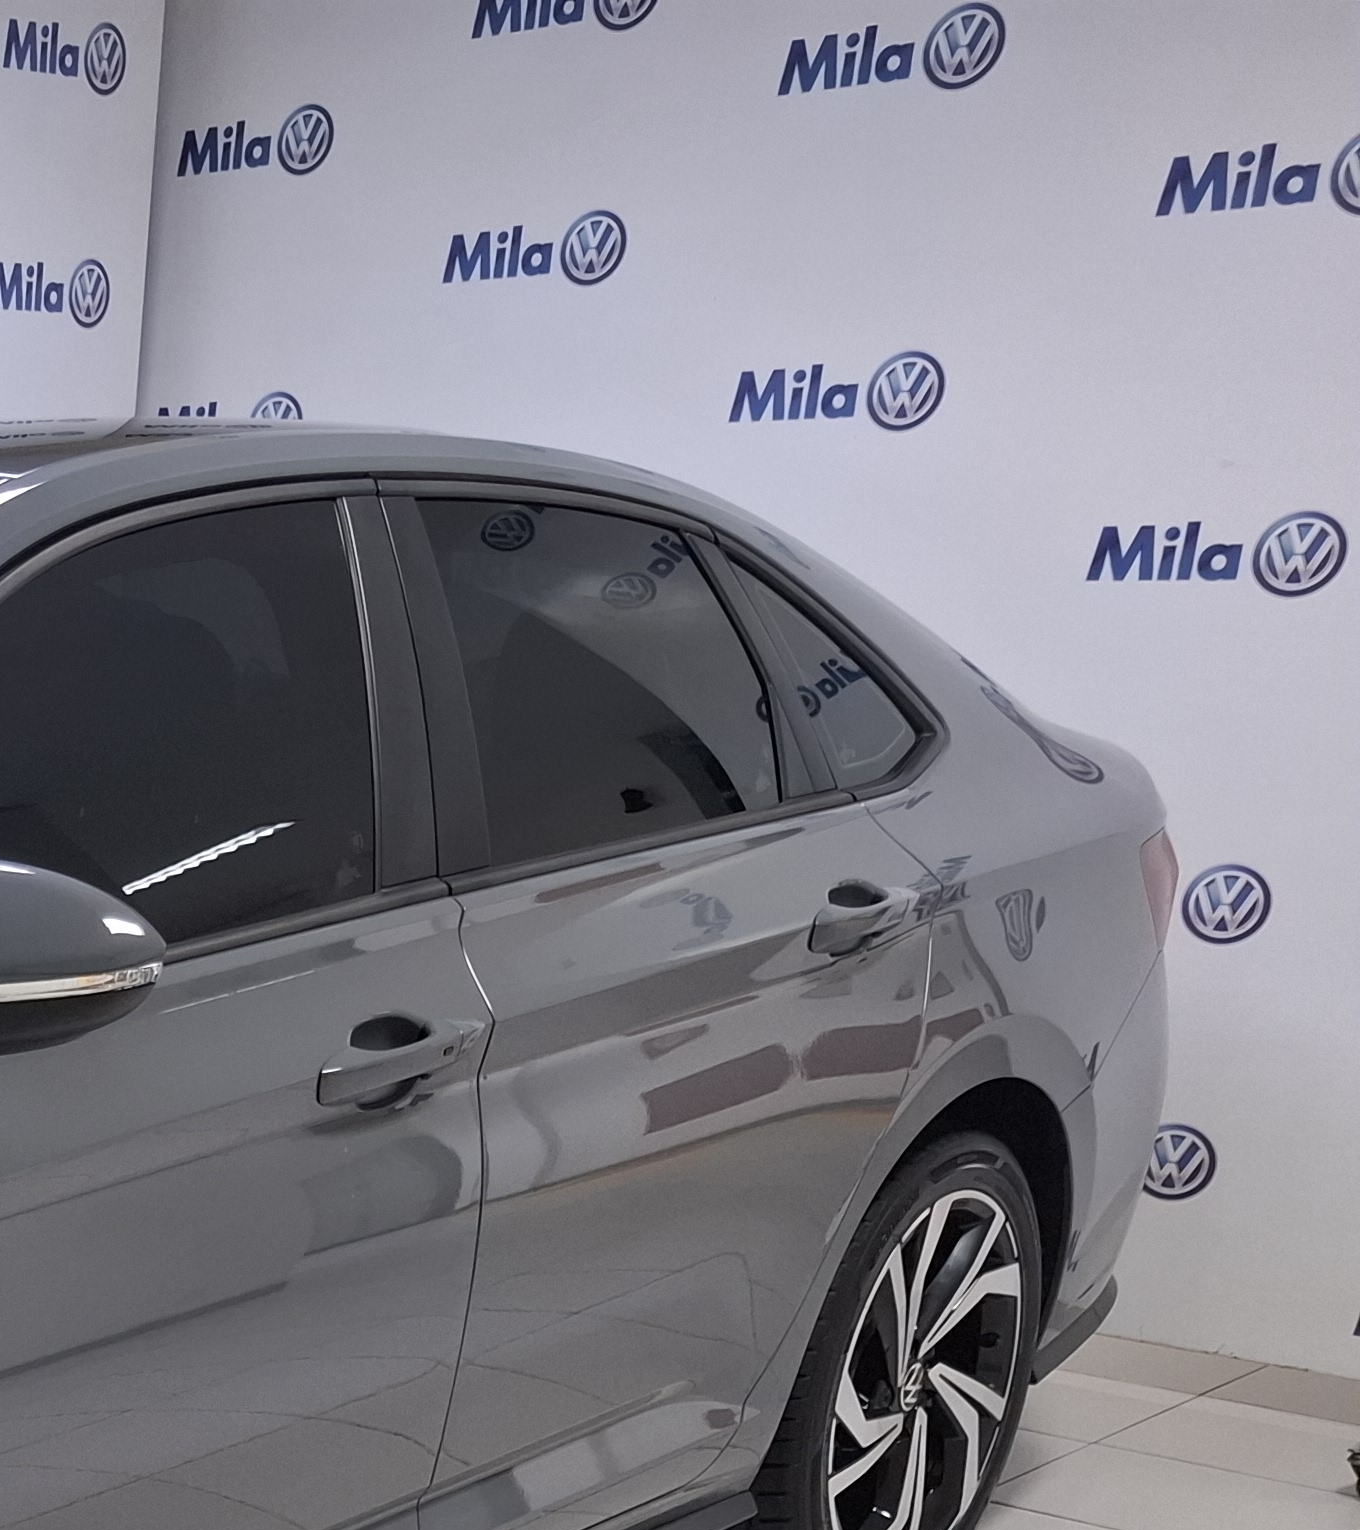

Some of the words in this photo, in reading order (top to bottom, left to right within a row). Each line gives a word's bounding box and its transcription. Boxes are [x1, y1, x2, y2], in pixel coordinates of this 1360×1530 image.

[3, 19, 79, 77] Mila
[778, 25, 915, 96] Mila
[176, 120, 271, 178] Mila
[1155, 143, 1321, 217] Mila
[443, 225, 553, 283] Mila
[729, 364, 859, 423] Mila
[1086, 521, 1243, 581] Mila
